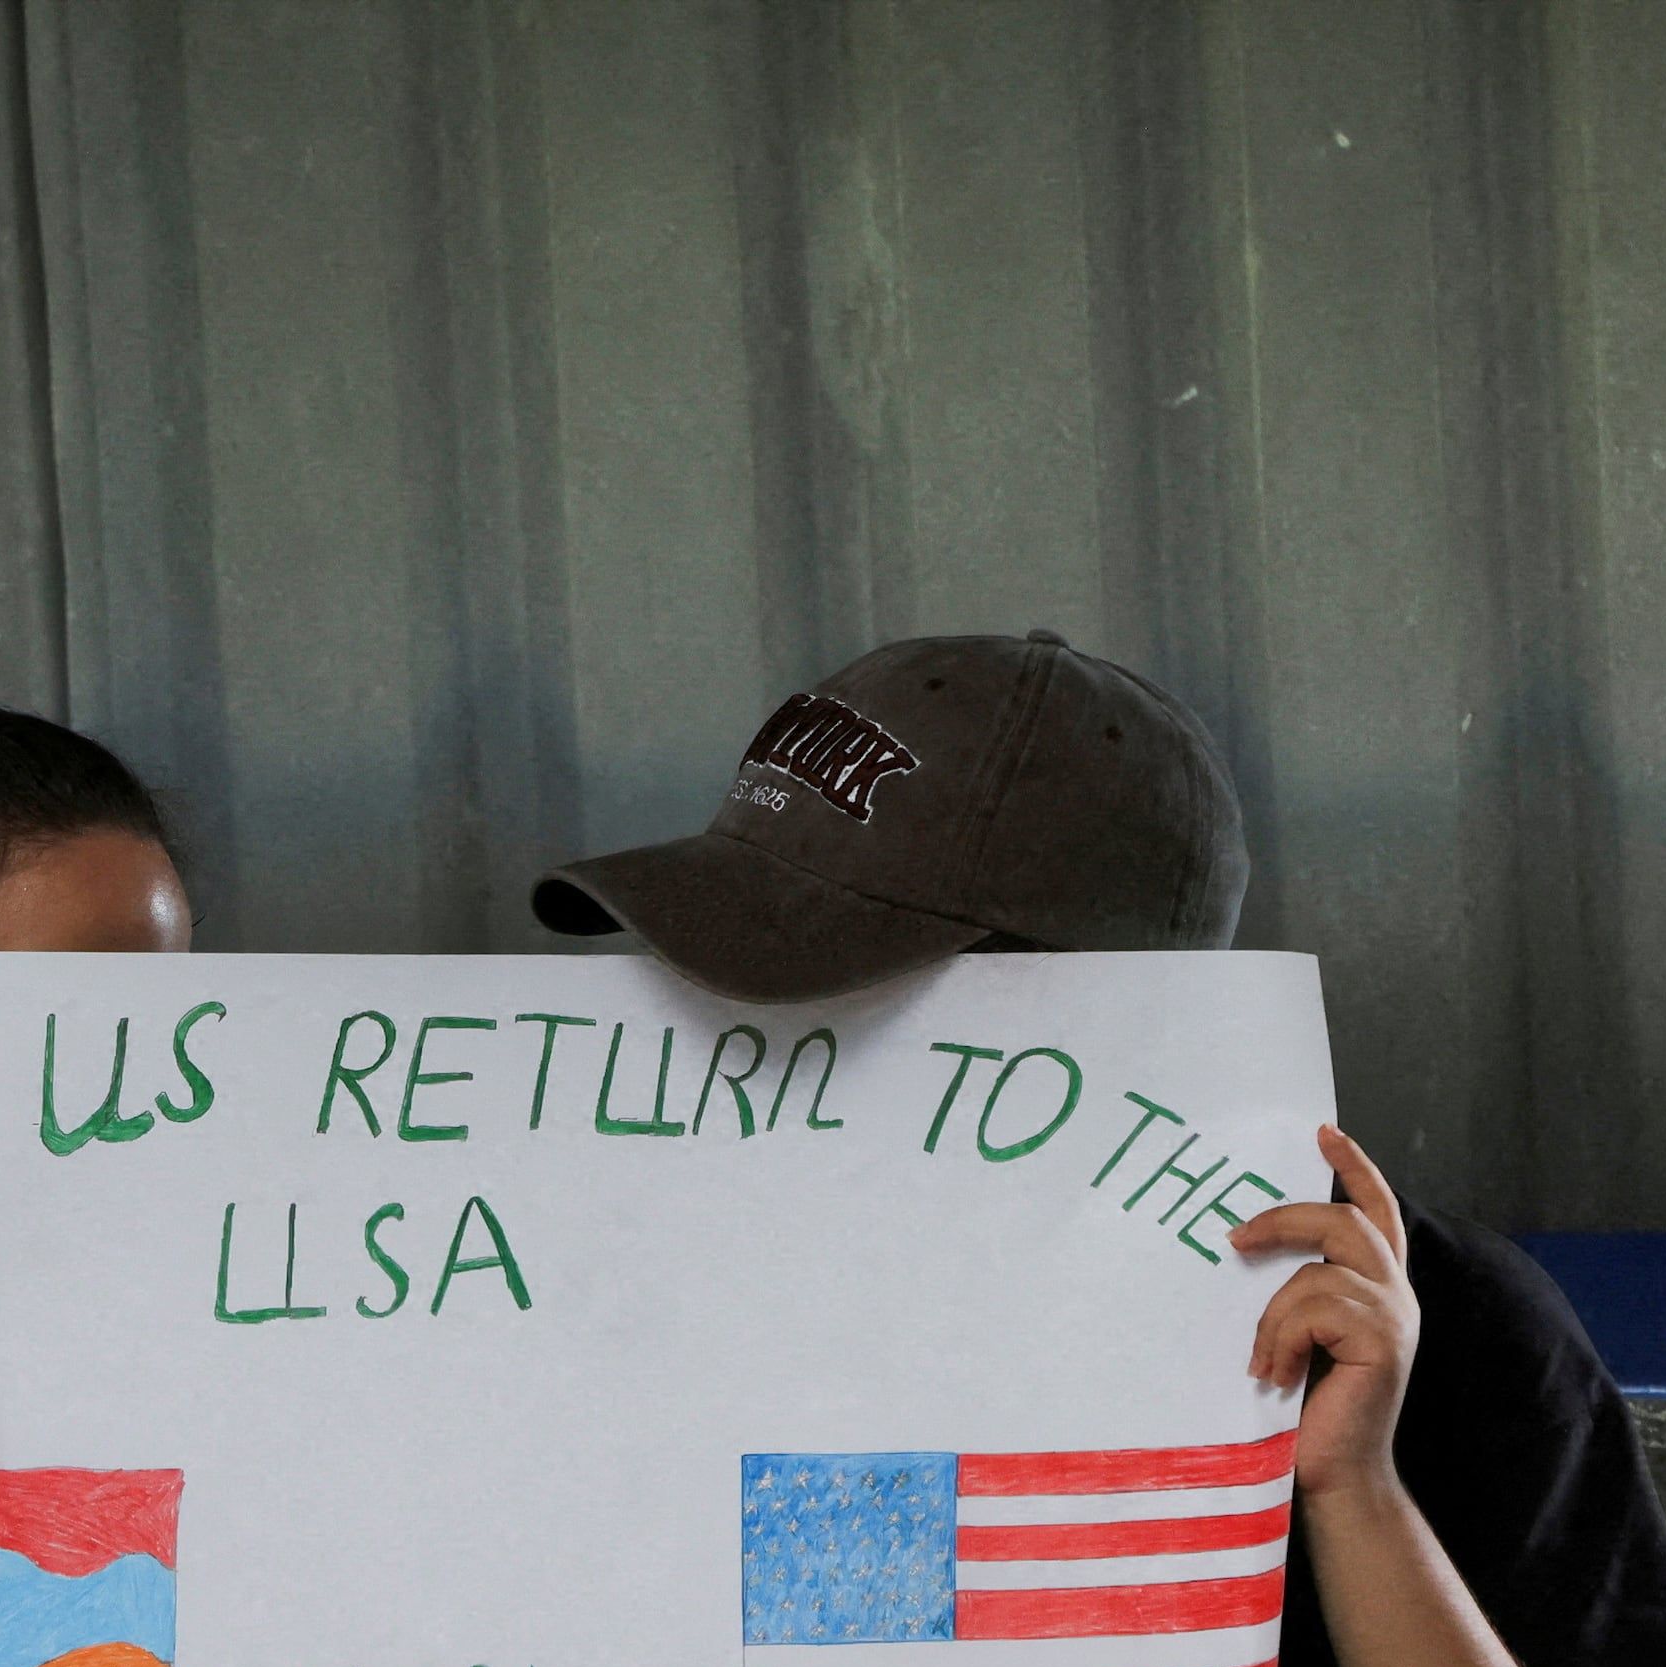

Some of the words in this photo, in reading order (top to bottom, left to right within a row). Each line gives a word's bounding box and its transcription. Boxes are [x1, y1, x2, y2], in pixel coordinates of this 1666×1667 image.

[39, 1001, 227, 1157] US
[923, 1043, 1083, 1162] TO
[1090, 1091, 1286, 1266] THE
[214, 1196, 533, 1324] USA
